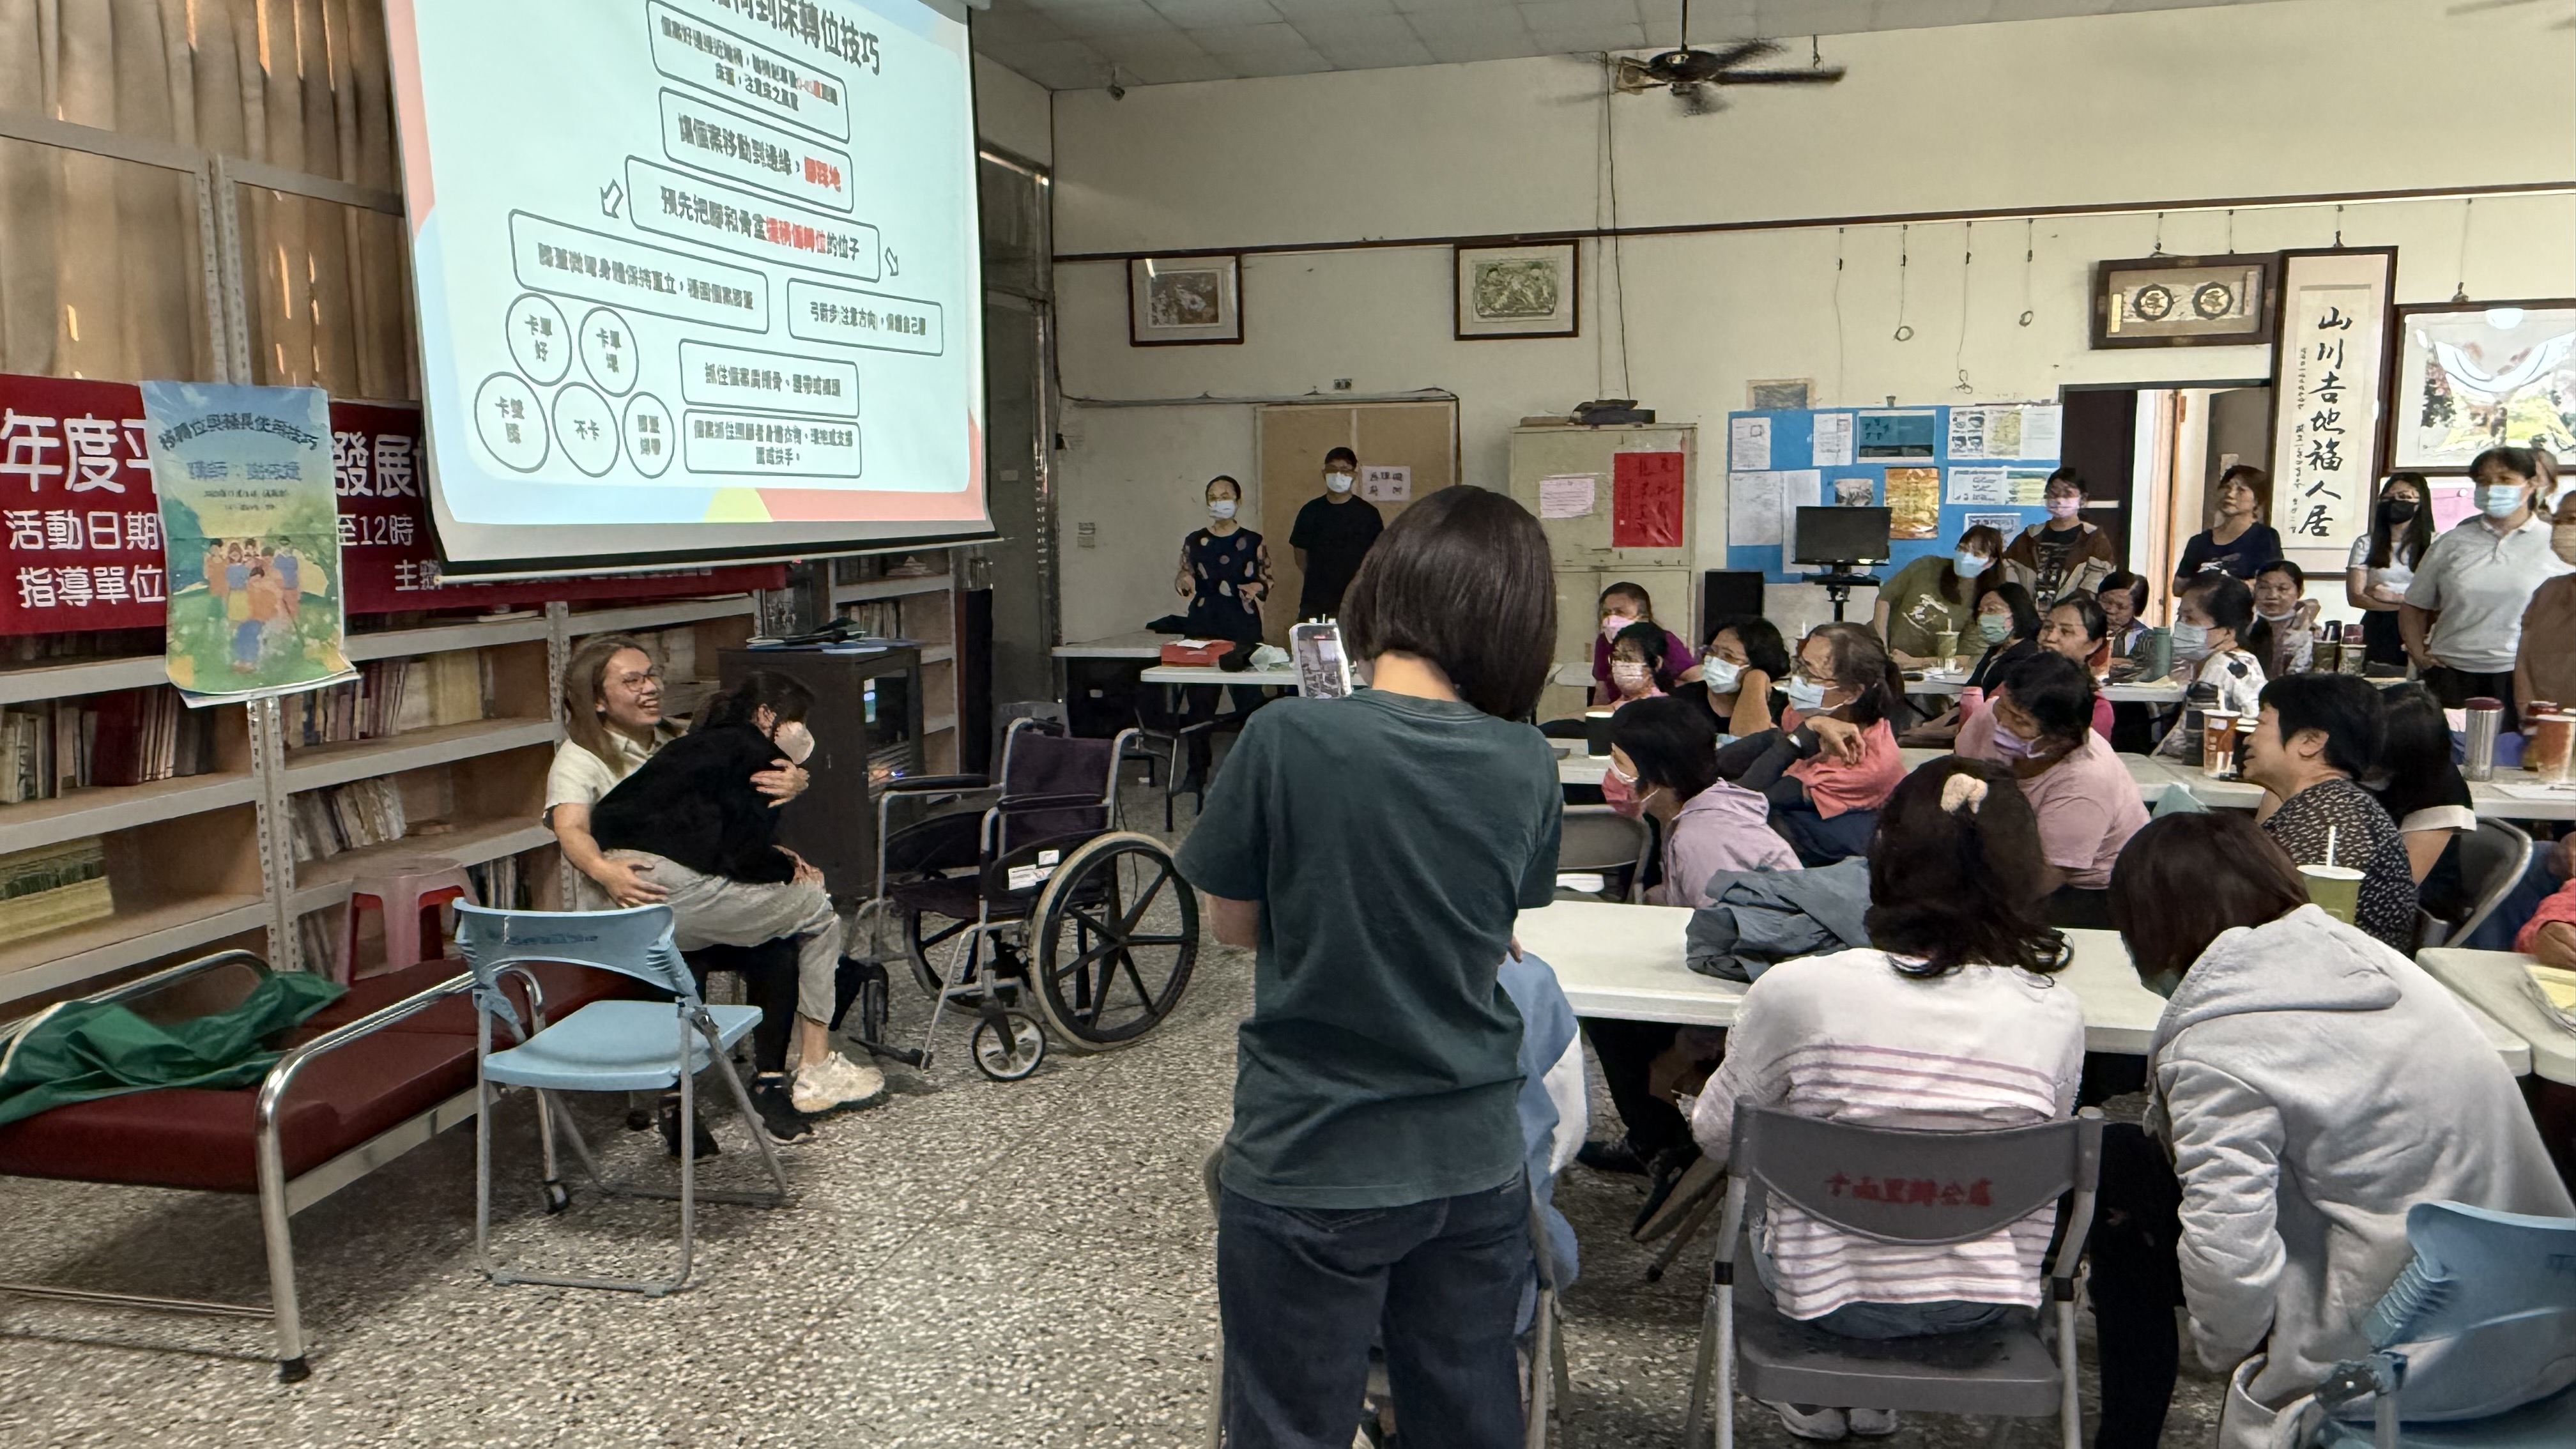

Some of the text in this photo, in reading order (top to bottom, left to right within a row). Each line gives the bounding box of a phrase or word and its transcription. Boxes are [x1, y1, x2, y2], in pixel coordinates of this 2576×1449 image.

[2298, 307, 2352, 537] 山川吉地福人居
[333, 431, 425, 497] 發展
[3, 510, 414, 550] 活動日期 至12時
[16, 564, 166, 608] 指導單位
